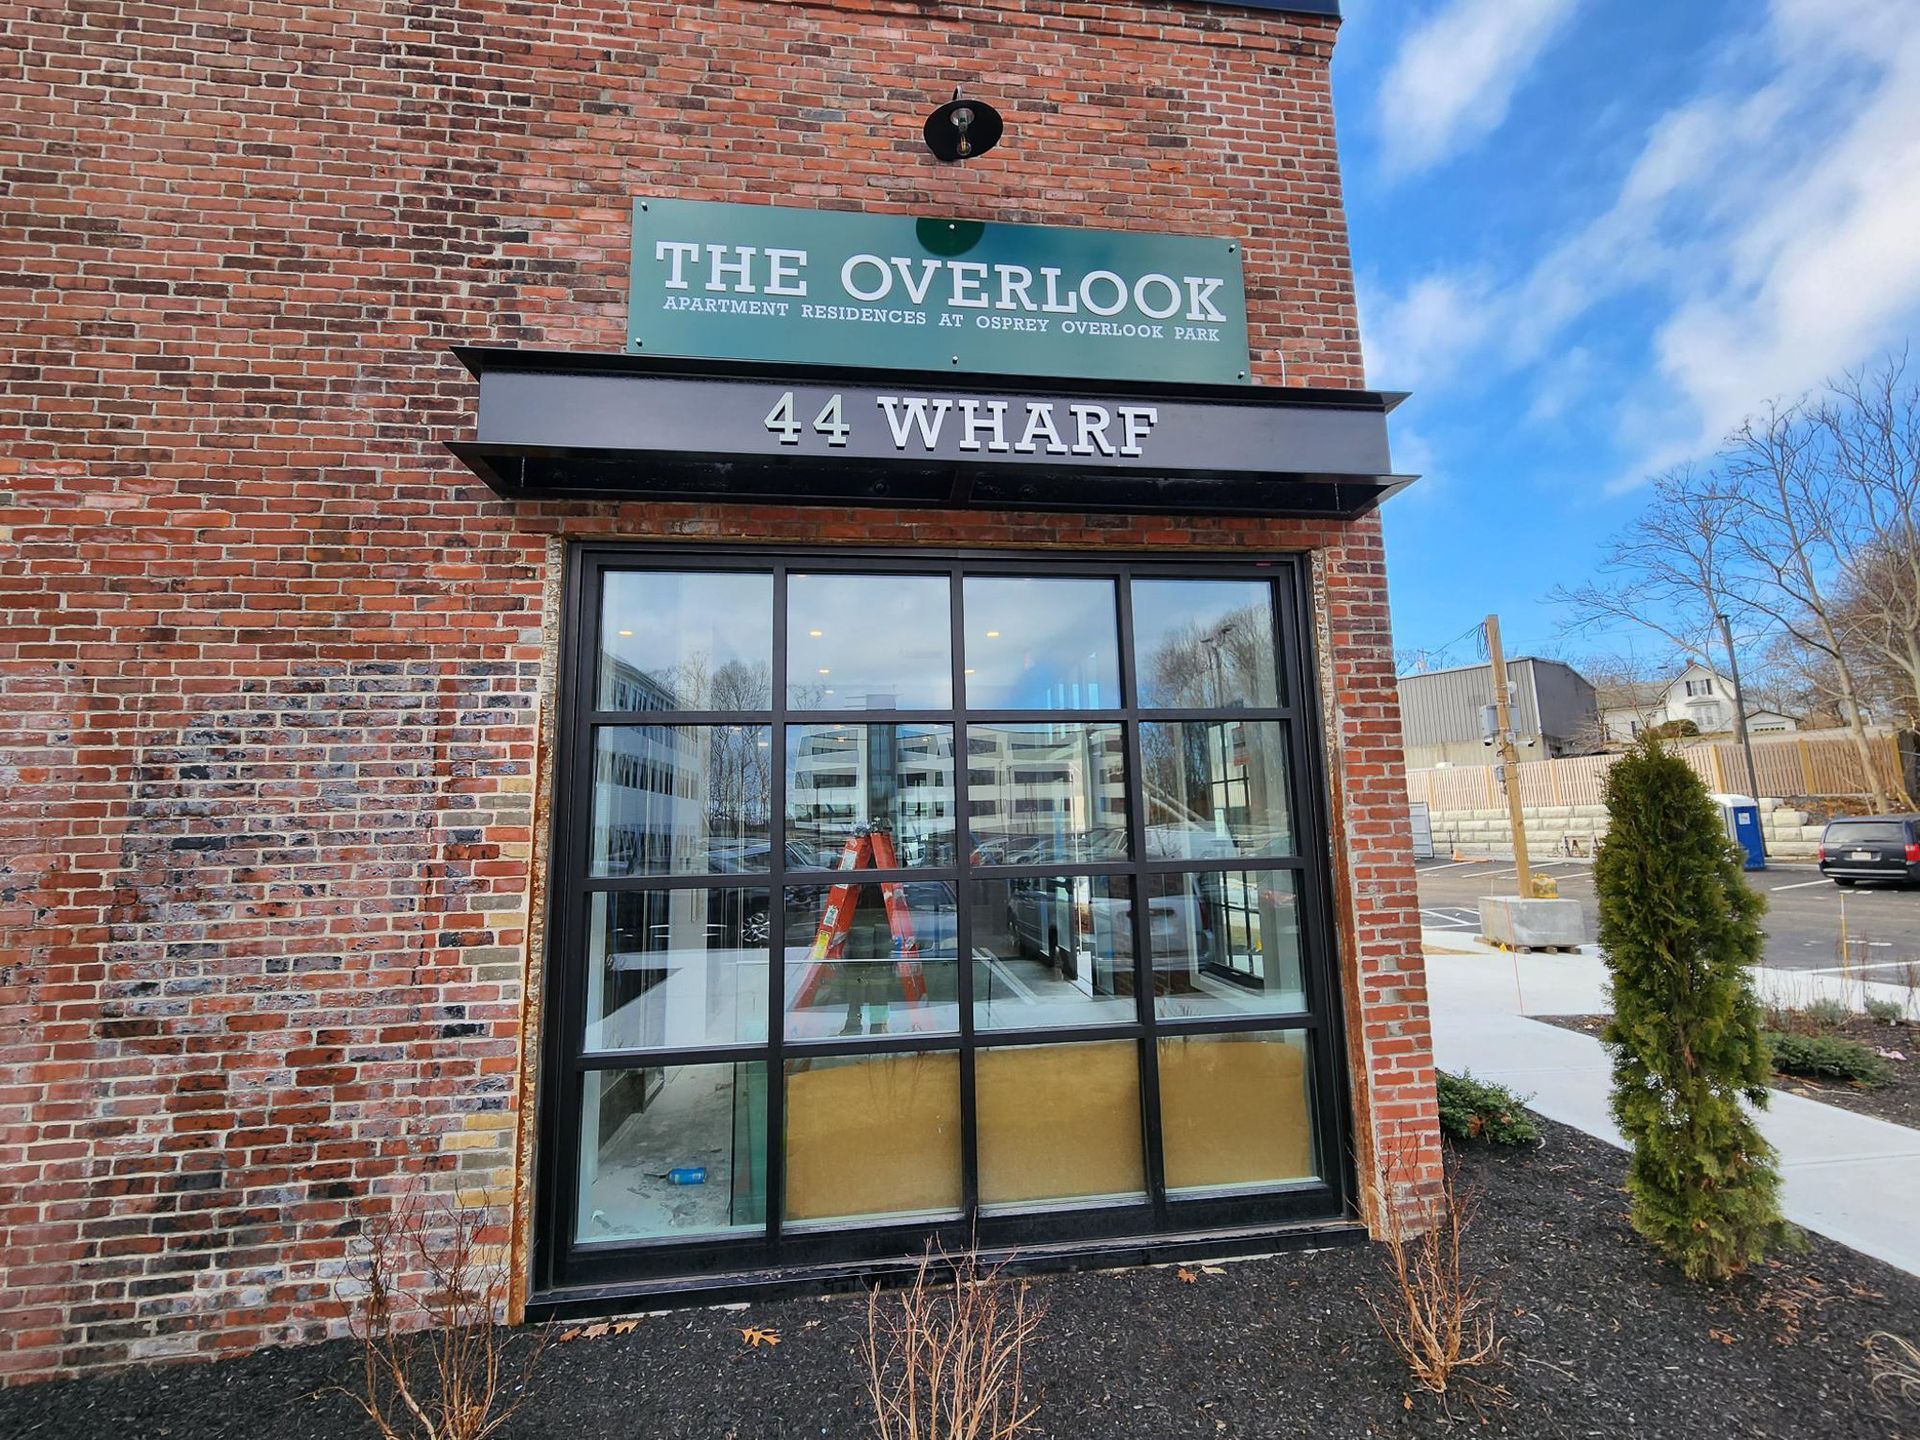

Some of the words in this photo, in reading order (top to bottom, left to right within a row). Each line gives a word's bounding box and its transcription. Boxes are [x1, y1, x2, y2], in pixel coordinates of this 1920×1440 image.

[656, 241, 808, 296] THE
[841, 254, 1227, 322] OVERLOOK
[663, 296, 789, 316] APARTMENT
[801, 304, 926, 325] RESIDENCES
[939, 313, 963, 328] AT
[976, 315, 1050, 333] OSPREY
[1061, 320, 1164, 339] OVERLOOK
[1174, 326, 1220, 342] PARK
[763, 391, 850, 445] 44
[877, 396, 1158, 455] WHARF
